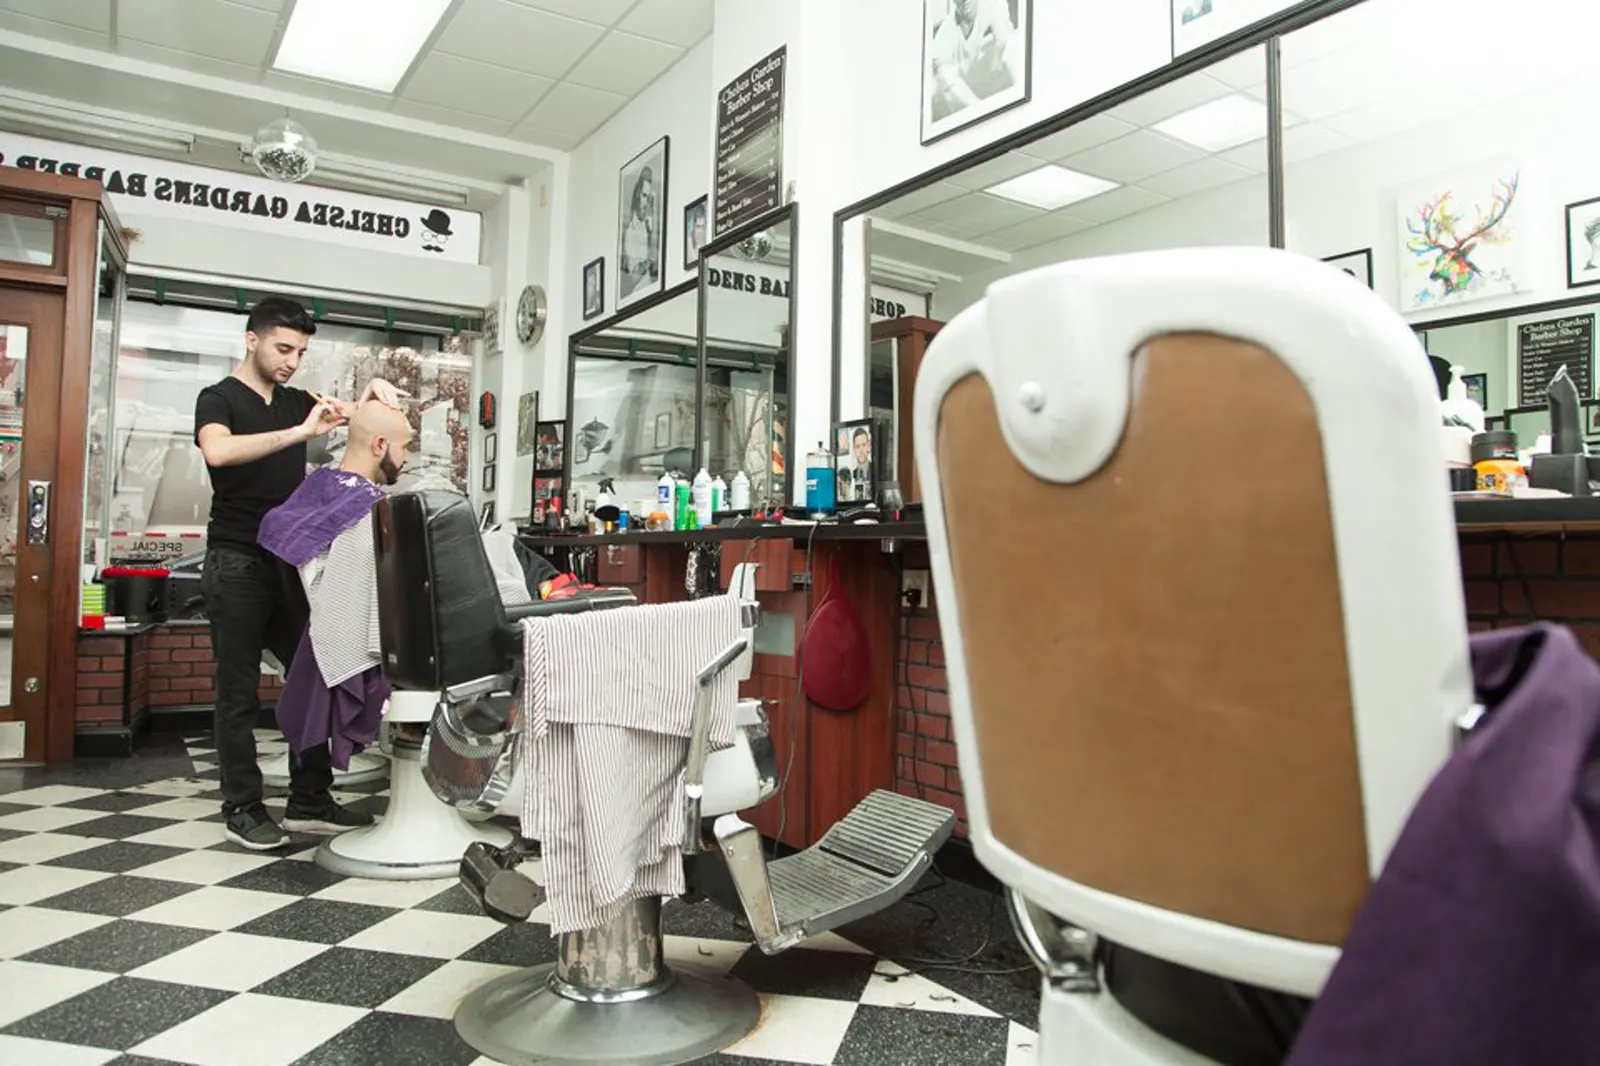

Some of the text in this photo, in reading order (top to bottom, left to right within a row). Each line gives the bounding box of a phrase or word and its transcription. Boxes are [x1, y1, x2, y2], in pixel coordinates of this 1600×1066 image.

[722, 57, 781, 103] Chelsea Garden
[727, 78, 774, 115] Barber Shop
[708, 267, 756, 293] DENS
[1523, 317, 1590, 334] Chelsea Garden
[1531, 327, 1583, 341] Barber Shop
